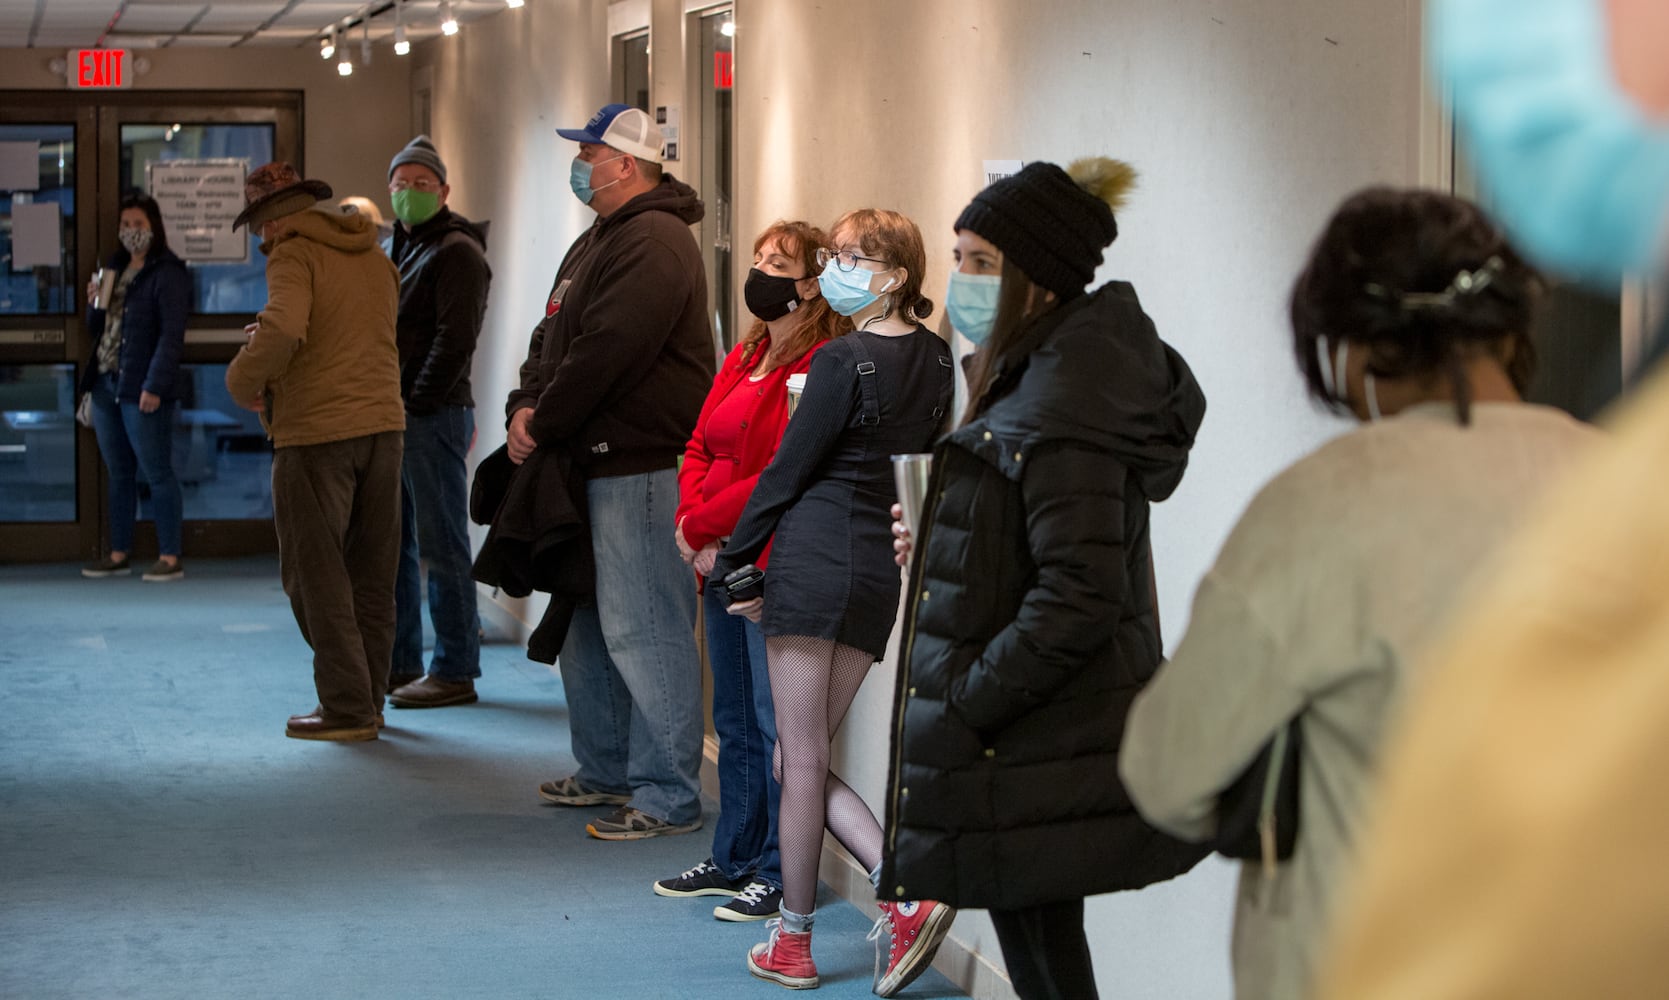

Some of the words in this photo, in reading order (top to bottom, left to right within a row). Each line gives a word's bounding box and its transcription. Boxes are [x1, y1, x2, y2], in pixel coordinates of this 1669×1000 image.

[78, 49, 125, 88] EXIT
[161, 175, 200, 184] LIBRARY
[203, 175, 236, 185] HOURS
[157, 191, 187, 200] Monday
[196, 190, 240, 200] Wednesday
[185, 235, 212, 243] Sunday
[185, 246, 213, 254] Closed
